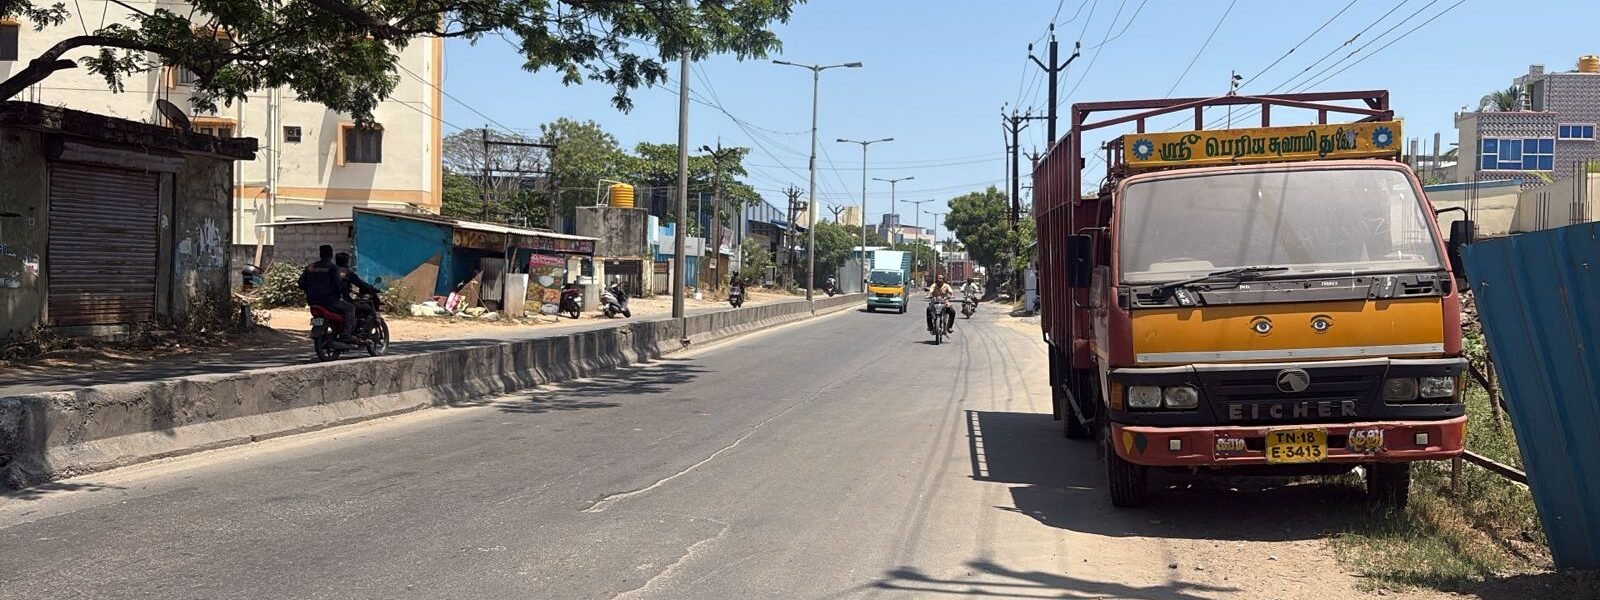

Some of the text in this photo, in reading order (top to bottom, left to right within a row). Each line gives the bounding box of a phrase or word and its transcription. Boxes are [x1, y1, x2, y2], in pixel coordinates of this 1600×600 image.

[1206, 135, 1265, 157] பெரிய
[1269, 130, 1317, 156] சுவாமி
[1229, 401, 1357, 420] EICHER
